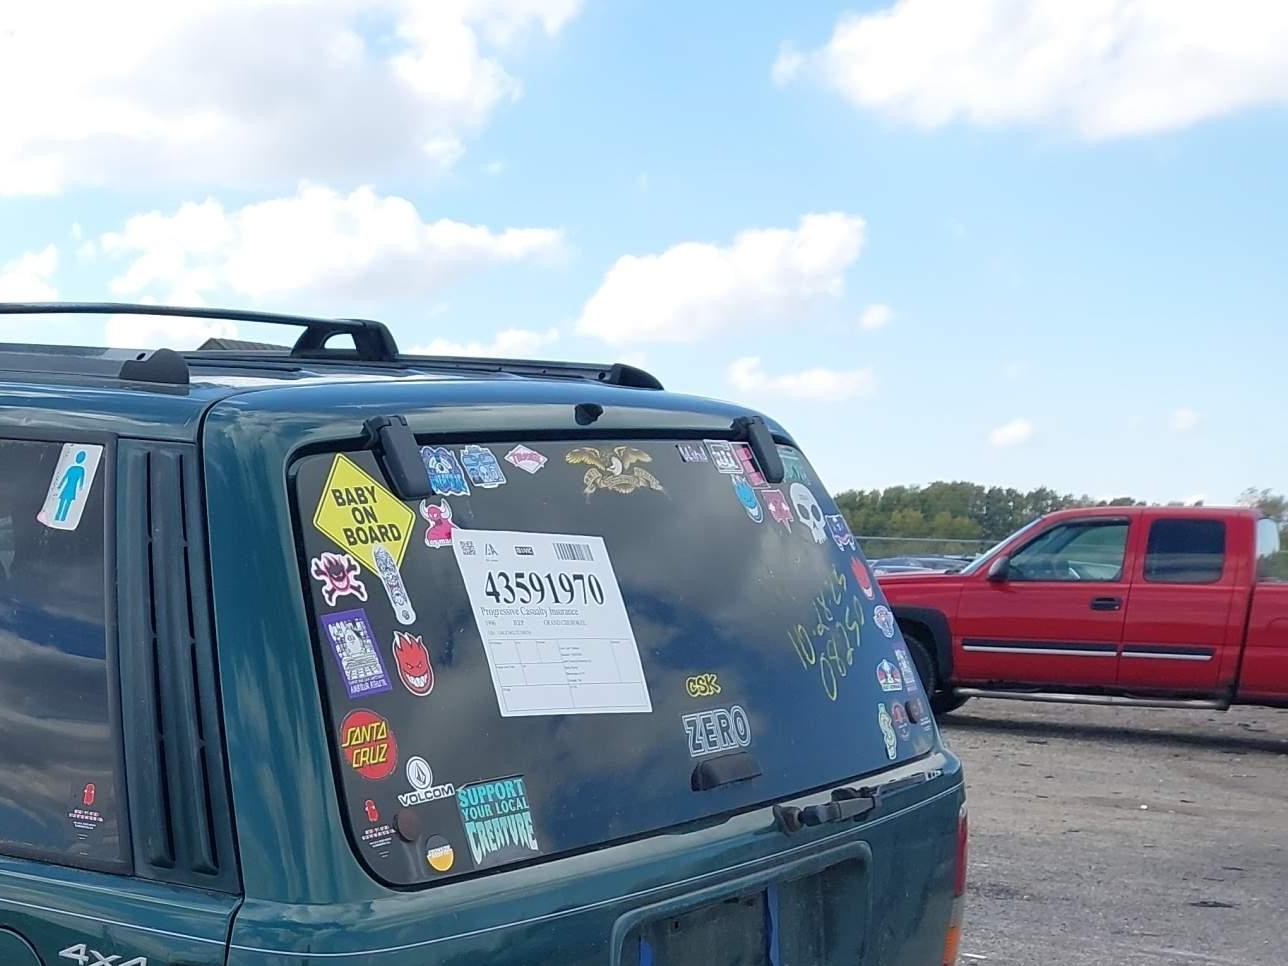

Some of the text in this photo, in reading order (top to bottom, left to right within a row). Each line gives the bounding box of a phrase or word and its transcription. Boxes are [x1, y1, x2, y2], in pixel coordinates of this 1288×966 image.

[331, 486, 377, 507] BABY
[351, 506, 378, 525] ON
[343, 524, 402, 546] BOARD
[485, 571, 605, 605] 43591970
[480, 607, 579, 618] Progressive Casualty Insurance
[341, 721, 388, 748] SANTA
[681, 705, 752, 757] ZERO
[352, 743, 388, 769] CRUZ
[398, 784, 456, 807] VOLCOM
[458, 778, 524, 807] SUPPORT
[461, 796, 530, 821] YOUR LOCAL
[465, 811, 539, 864] CREATURE
